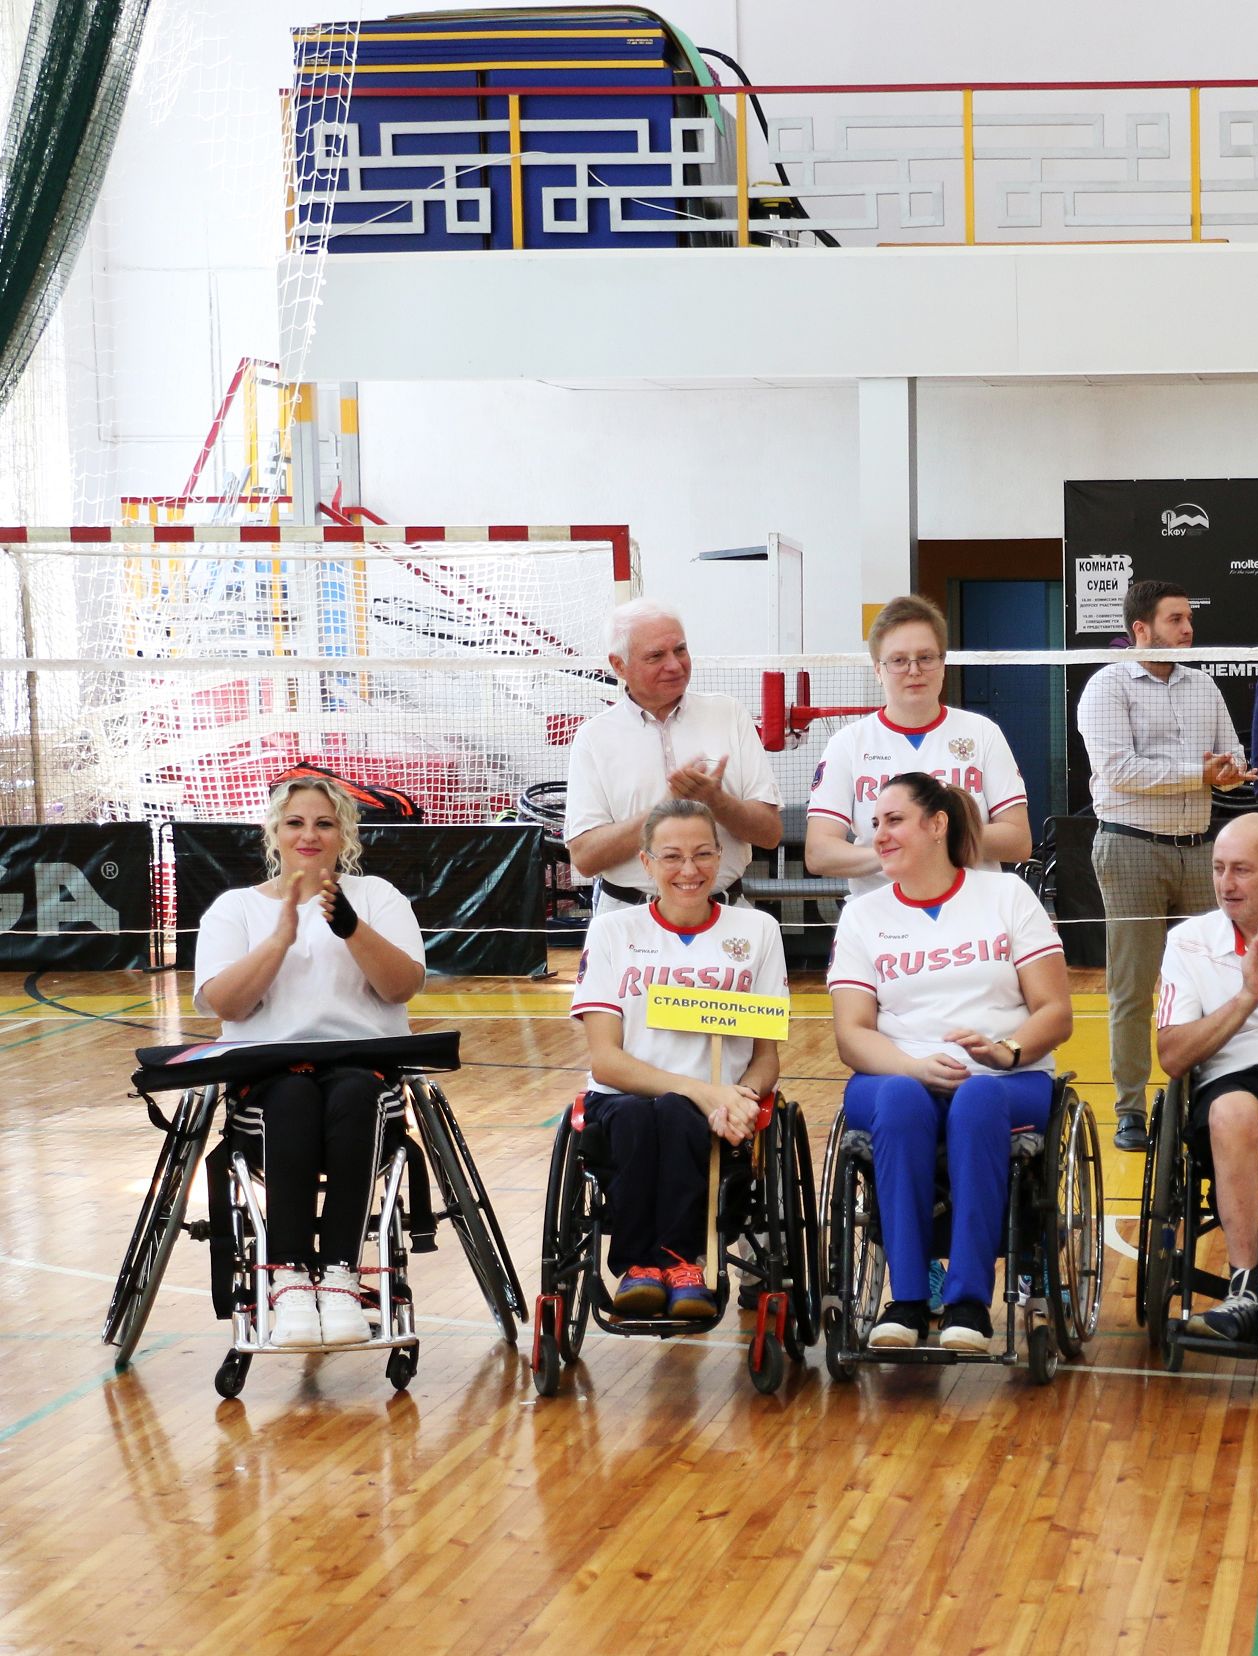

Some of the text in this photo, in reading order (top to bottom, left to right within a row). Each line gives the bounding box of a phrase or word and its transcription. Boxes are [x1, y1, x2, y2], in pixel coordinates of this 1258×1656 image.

[1161, 527, 1187, 537] СКФУ
[1080, 561, 1125, 572] КОМНАТА
[1087, 577, 1118, 592] СУДЕЙ
[874, 932, 1012, 984] RUSSIA
[653, 996, 786, 1017] СТАВРОПОЛЬСКИЙ
[700, 1014, 737, 1027] КРАЙ
